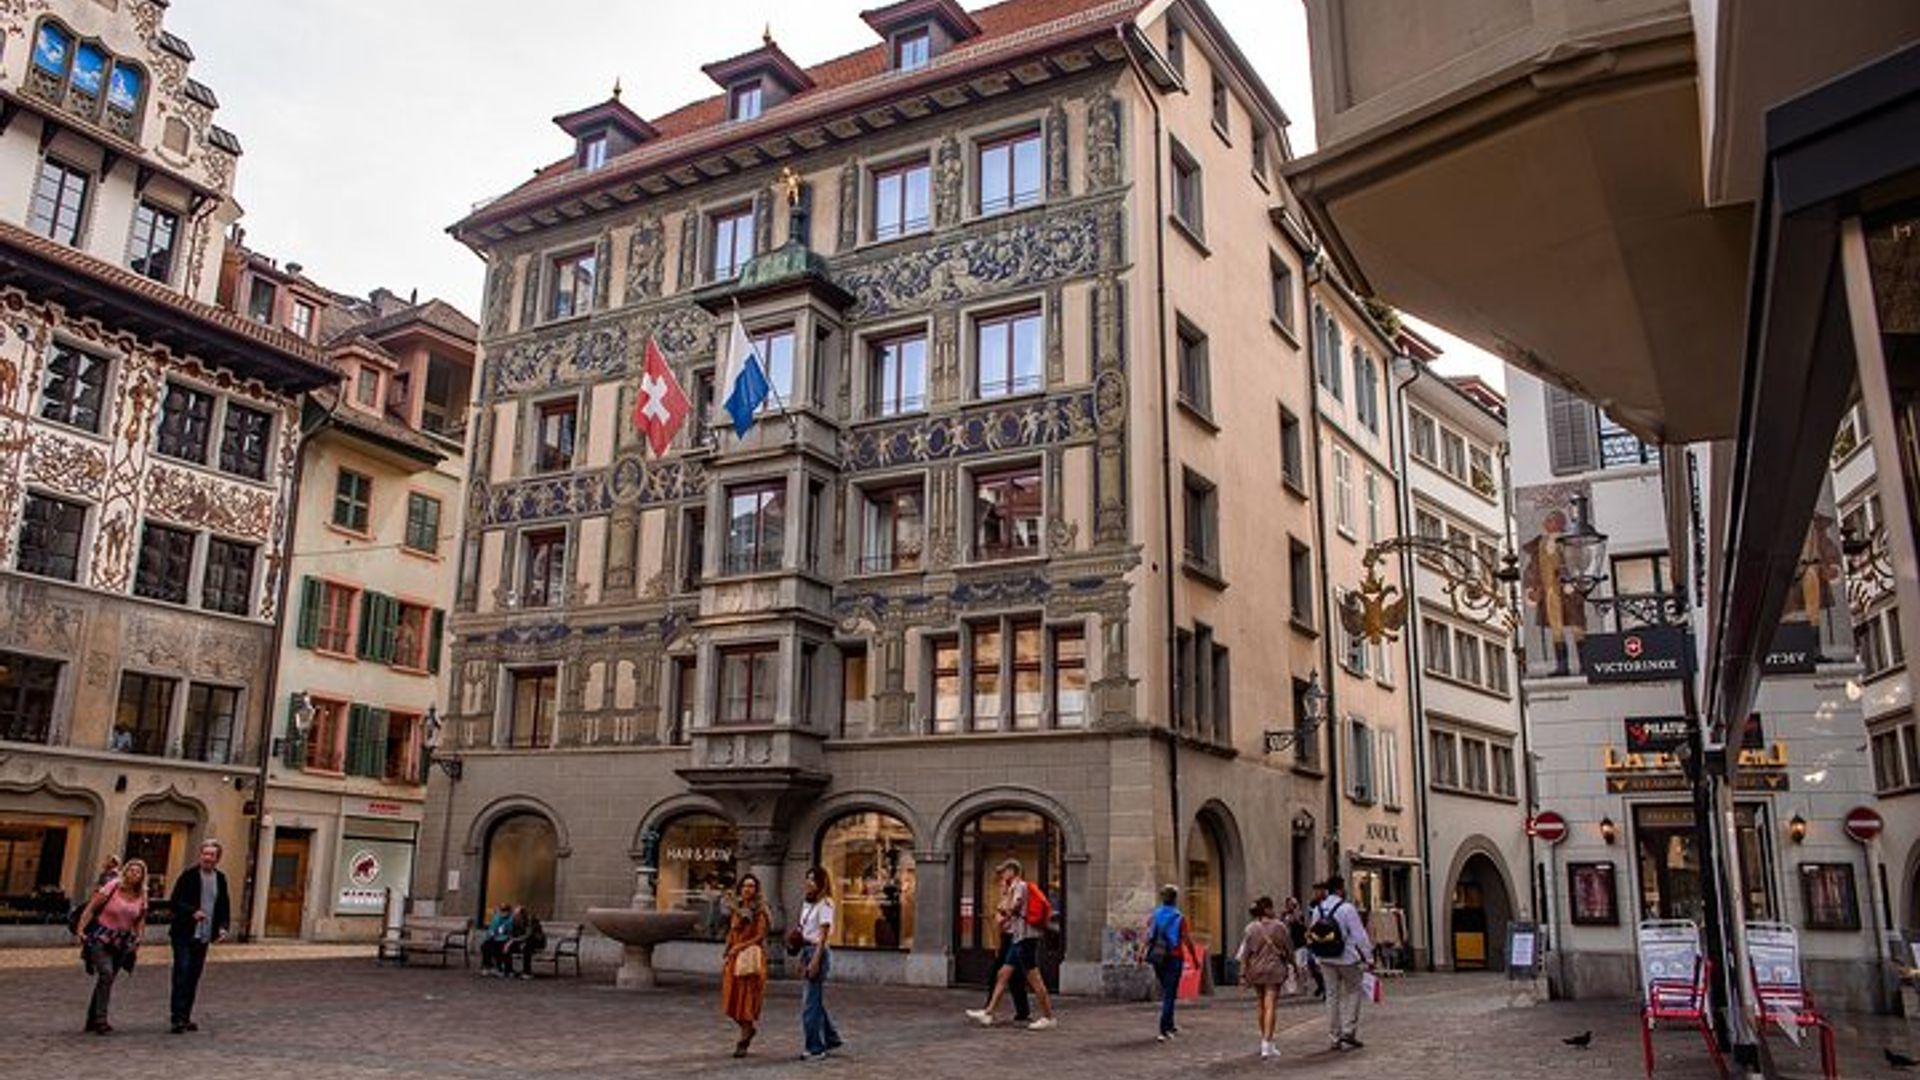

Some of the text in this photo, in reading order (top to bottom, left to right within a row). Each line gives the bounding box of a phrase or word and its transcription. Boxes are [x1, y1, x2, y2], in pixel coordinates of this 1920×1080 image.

[1594, 660, 1679, 673] VICTORINOX
[667, 848, 690, 860] HAIR
[694, 848, 702, 861] &
